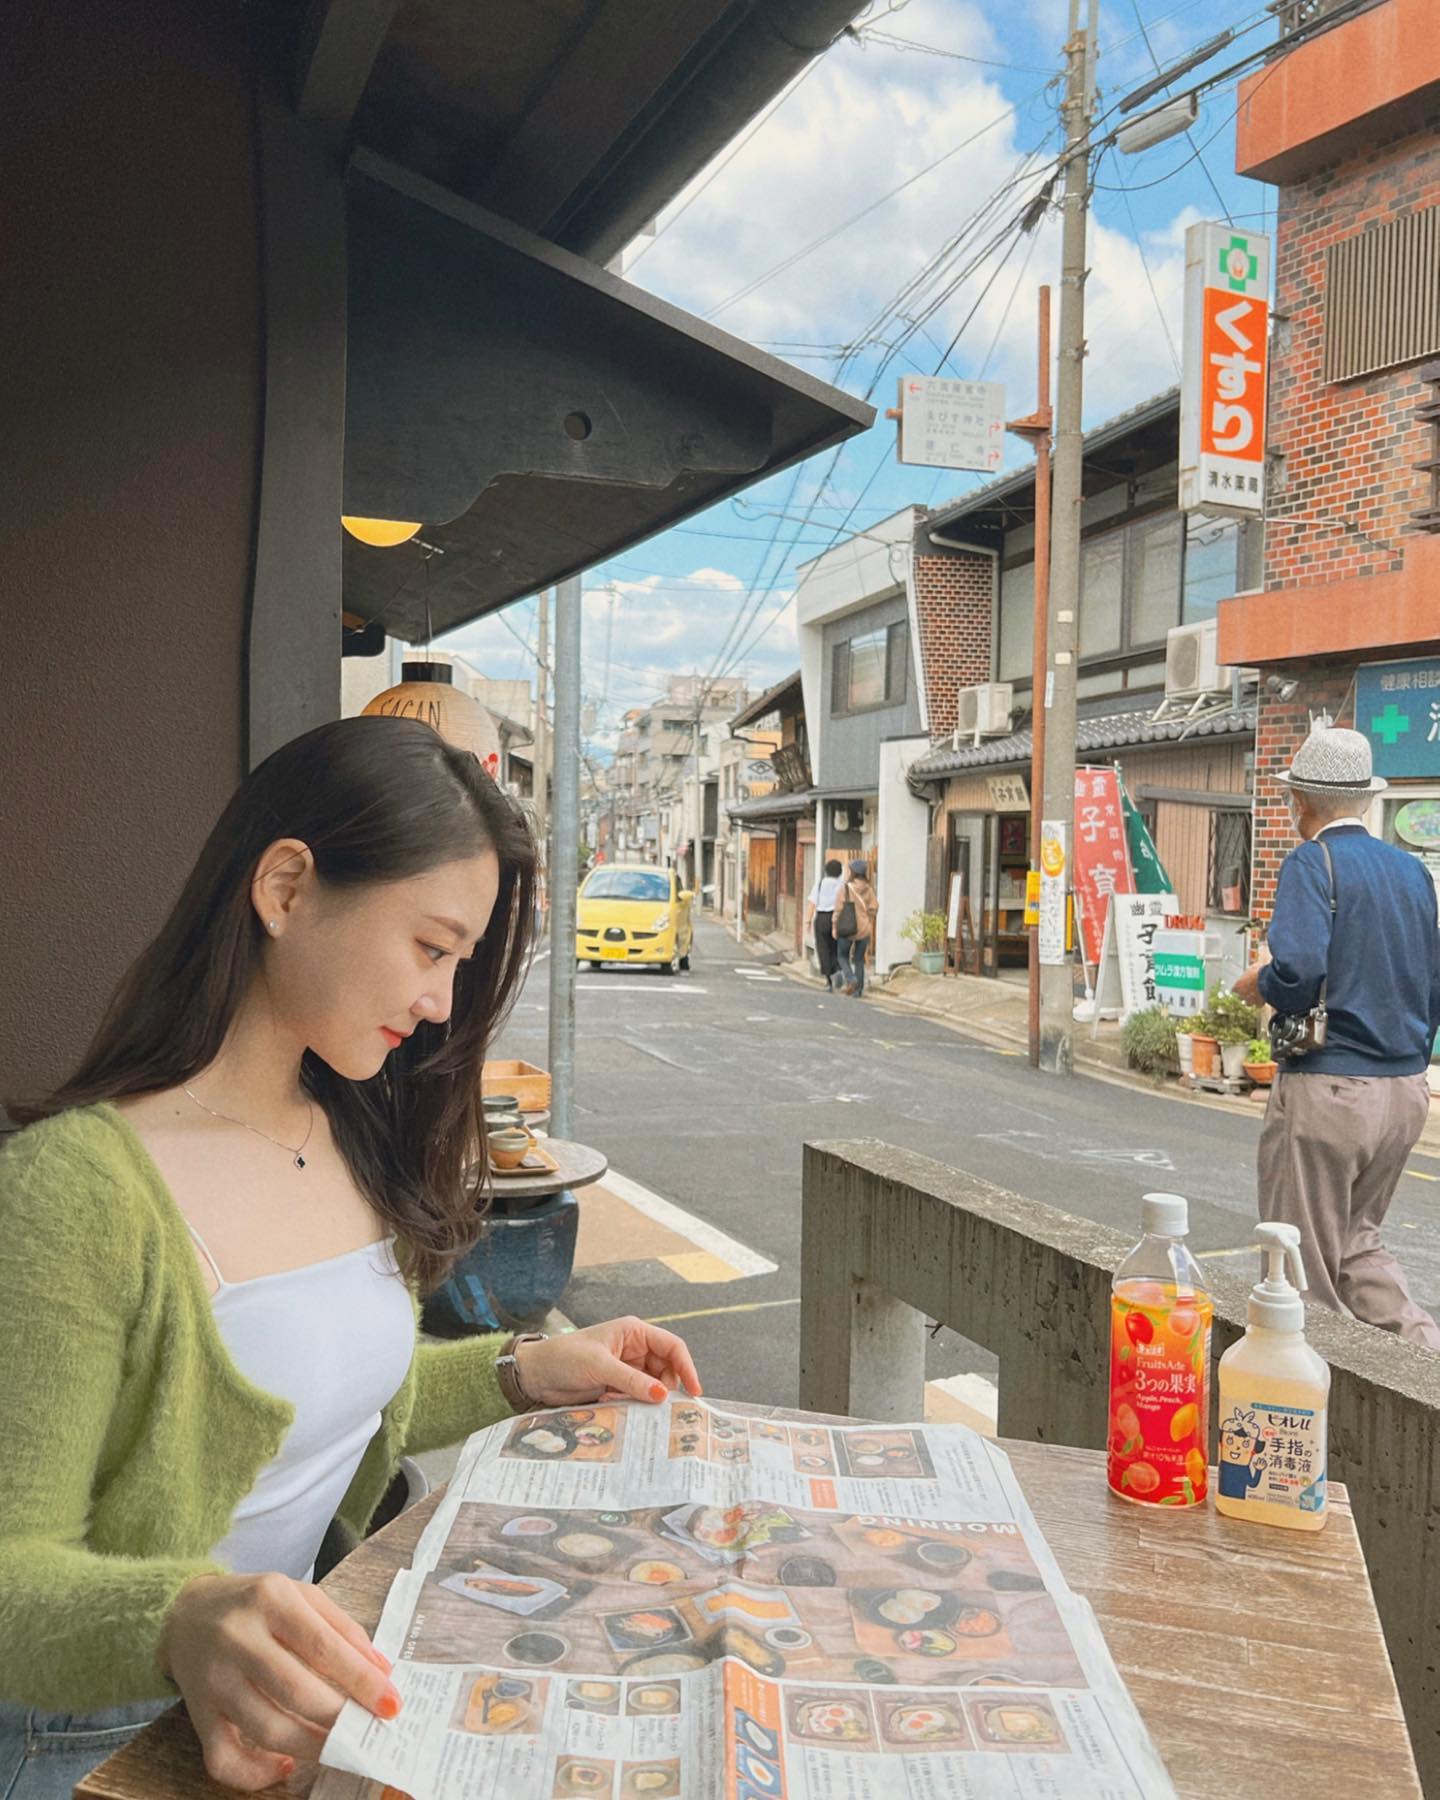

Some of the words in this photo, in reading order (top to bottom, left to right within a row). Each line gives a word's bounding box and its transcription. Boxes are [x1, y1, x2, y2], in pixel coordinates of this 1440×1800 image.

[1209, 300, 1262, 452] くすり
[1208, 471, 1259, 495] 清水薬局
[1165, 914, 1206, 930] DRUG
[1135, 1369, 1197, 1394] 3つの果実
[1269, 1437, 1313, 1458] 手指の
[1269, 1454, 1313, 1474] 消毒液
[856, 1514, 1017, 1535] MORNING
